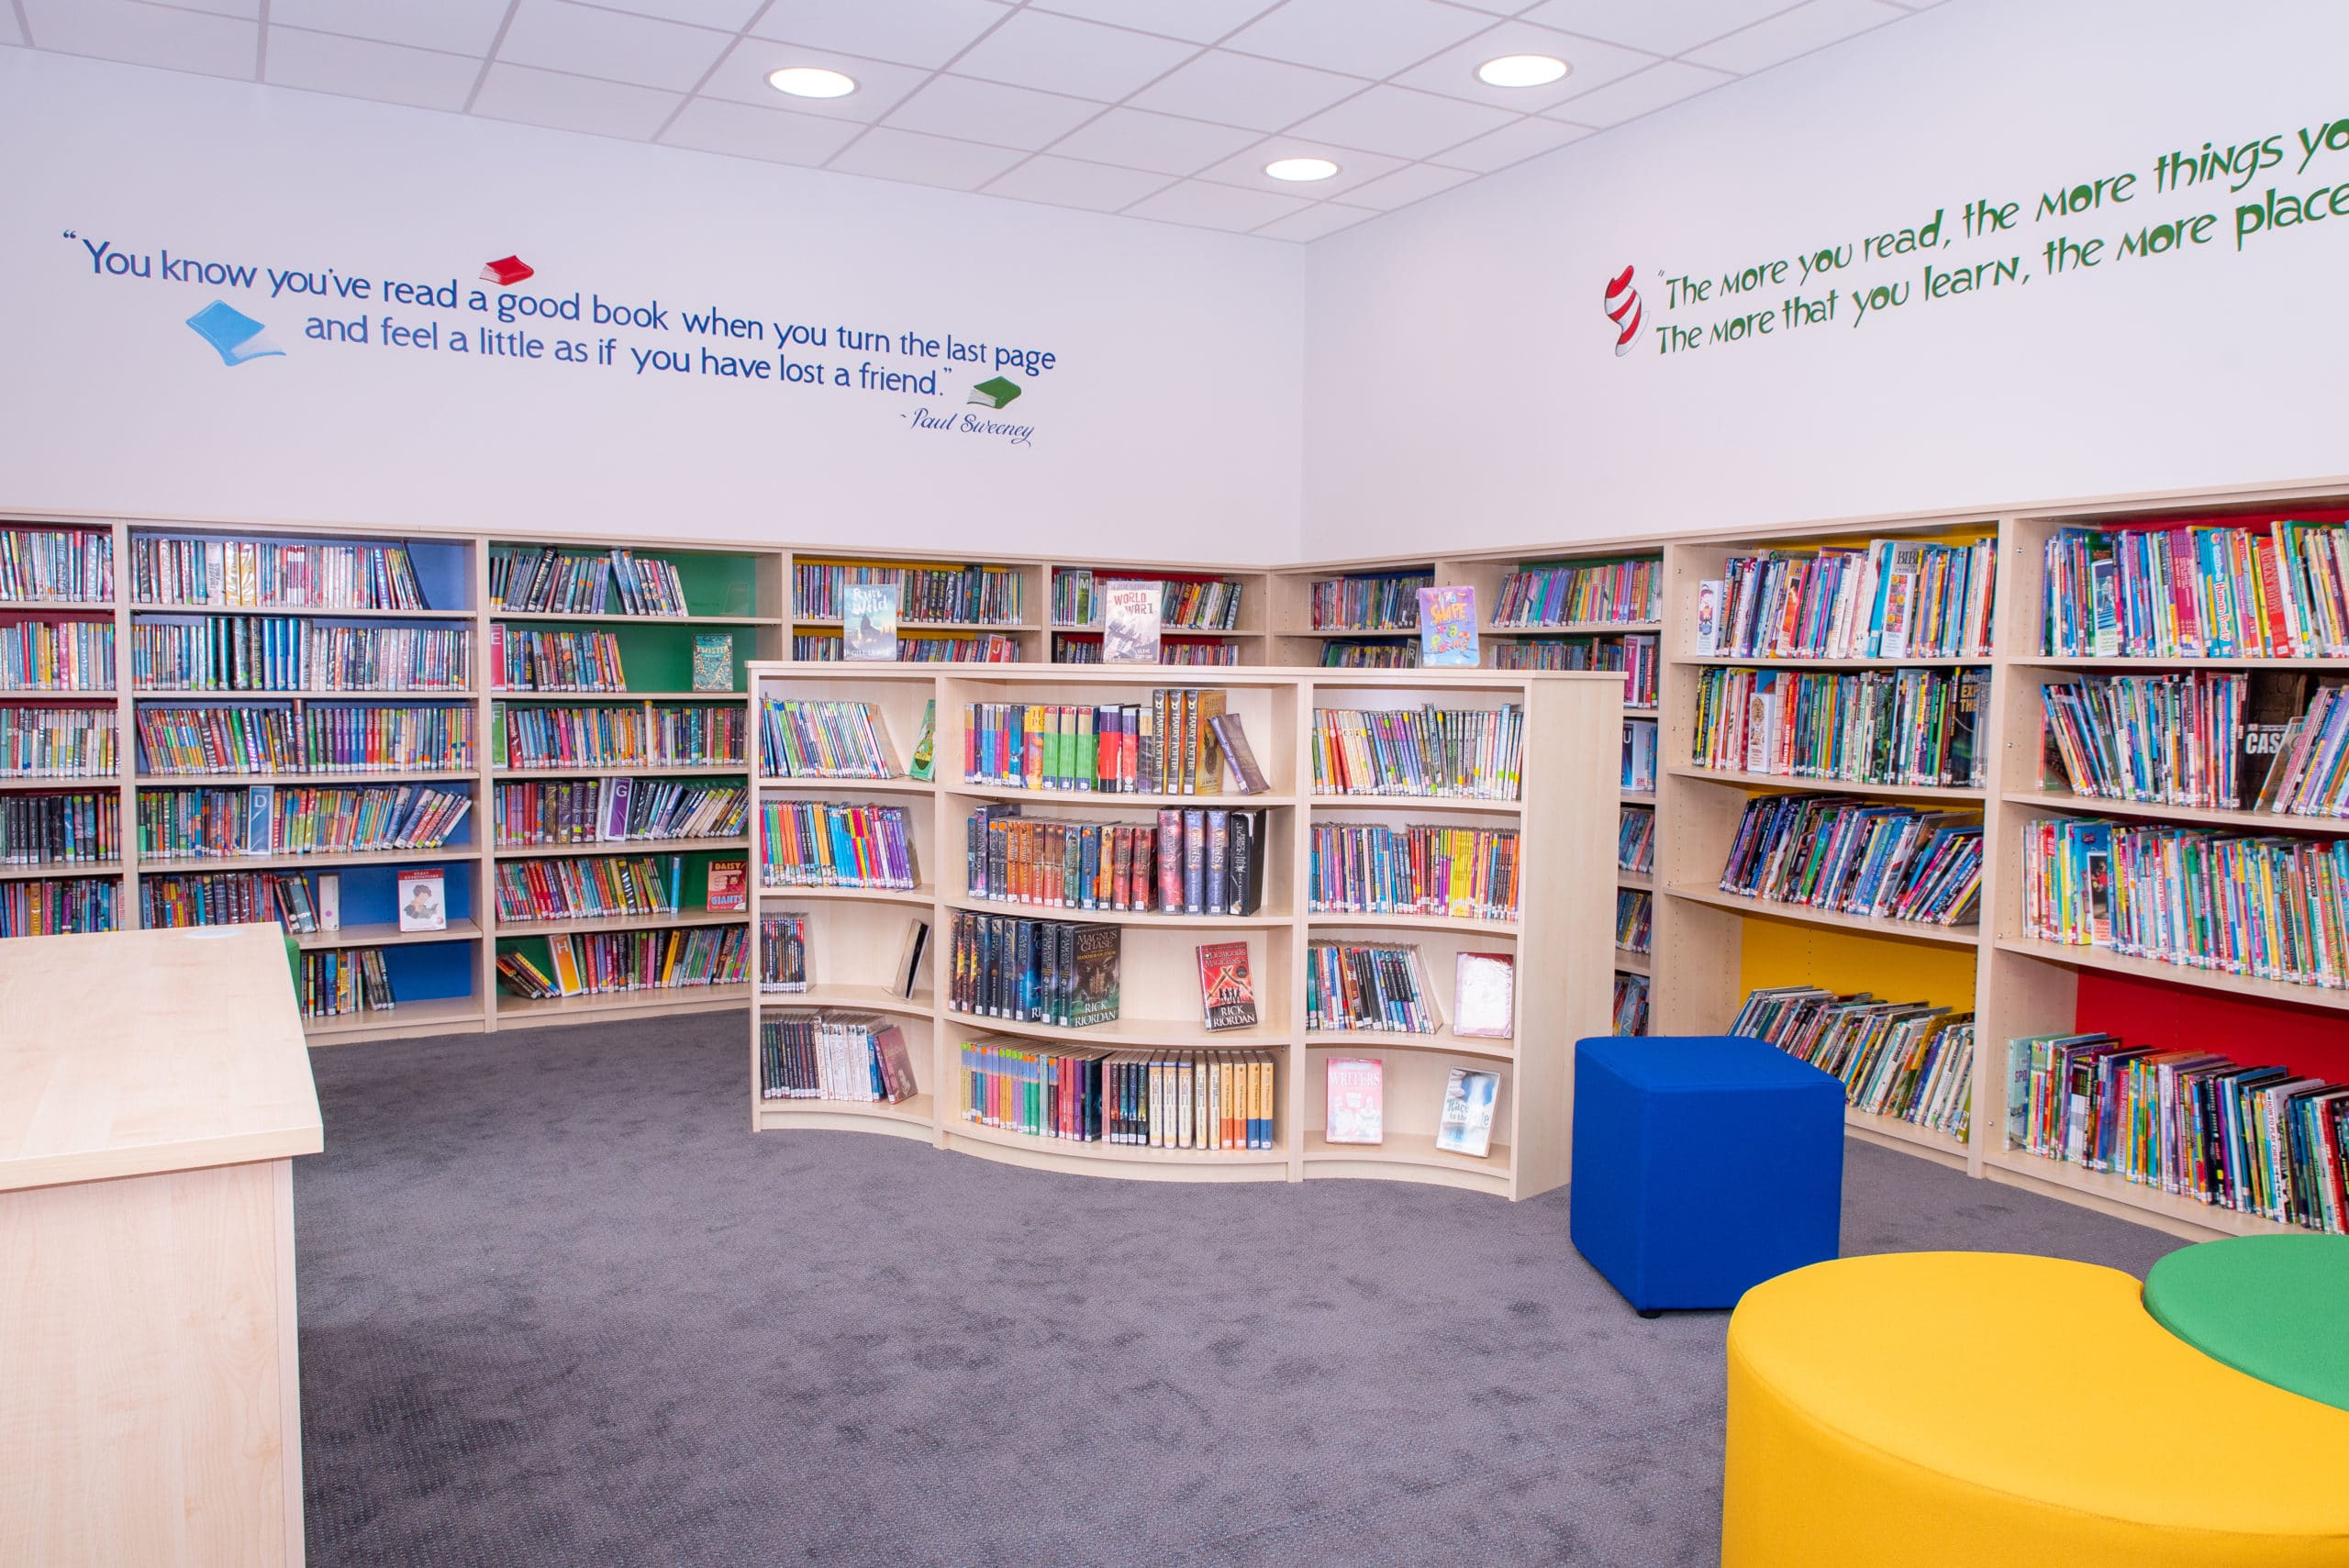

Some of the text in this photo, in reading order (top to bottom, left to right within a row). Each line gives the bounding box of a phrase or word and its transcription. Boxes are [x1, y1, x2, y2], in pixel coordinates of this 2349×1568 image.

[1798, 243, 1852, 284] you
[1865, 209, 1951, 259] read,
[1962, 197, 2021, 237] the
[1656, 326, 1703, 354] The
[1781, 288, 1837, 328] that
[1851, 279, 1909, 328] you
[2043, 235, 2105, 275] the
[161, 250, 256, 287] know
[384, 279, 457, 307] read
[468, 291, 486, 311] a
[497, 293, 579, 323] good
[593, 295, 667, 329] book
[682, 306, 763, 339] when
[774, 323, 826, 349] you
[837, 327, 889, 352] turn
[901, 332, 940, 357] the
[947, 335, 985, 361] last
[995, 346, 1056, 376] page
[306, 315, 367, 343] and
[382, 317, 439, 350] feel
[450, 331, 468, 351] a
[480, 327, 543, 358] little
[554, 340, 587, 361] as
[599, 338, 615, 364] if
[631, 348, 689, 374] you
[702, 347, 770, 378] have
[780, 354, 822, 384] lost
[834, 368, 850, 386] a
[911, 407, 1035, 447] Paul Sweeney
[1079, 578, 1089, 589] M
[1114, 592, 1147, 606] WORLD
[2214, 582, 2227, 614] Human
[1125, 604, 1145, 615] WAR
[2219, 614, 2231, 641] Body
[490, 632, 501, 645] E
[696, 645, 730, 655] TWISTER
[993, 643, 1000, 654] J
[1408, 649, 1416, 660] R
[1627, 644, 1635, 659] T
[492, 710, 501, 723] F
[1156, 712, 1164, 738] HARRY
[1623, 730, 1631, 744] U
[2245, 732, 2277, 754] CAS
[1171, 741, 1180, 771] POTTER
[1187, 741, 1197, 771] POTTER
[616, 784, 628, 797] G
[254, 795, 267, 807] D
[710, 895, 743, 905] GIANTS
[1077, 929, 1118, 946] MAGNUS
[556, 940, 569, 954] H
[1081, 941, 1113, 952] CHASE
[1085, 1001, 1107, 1014] RICK
[1221, 1006, 1244, 1016] RICK
[1074, 1010, 1117, 1027] RIORDAN
[1213, 1014, 1256, 1028] RIORDAN
[1329, 1072, 1380, 1087] WRITERS
[2268, 1118, 2275, 1126] TO
